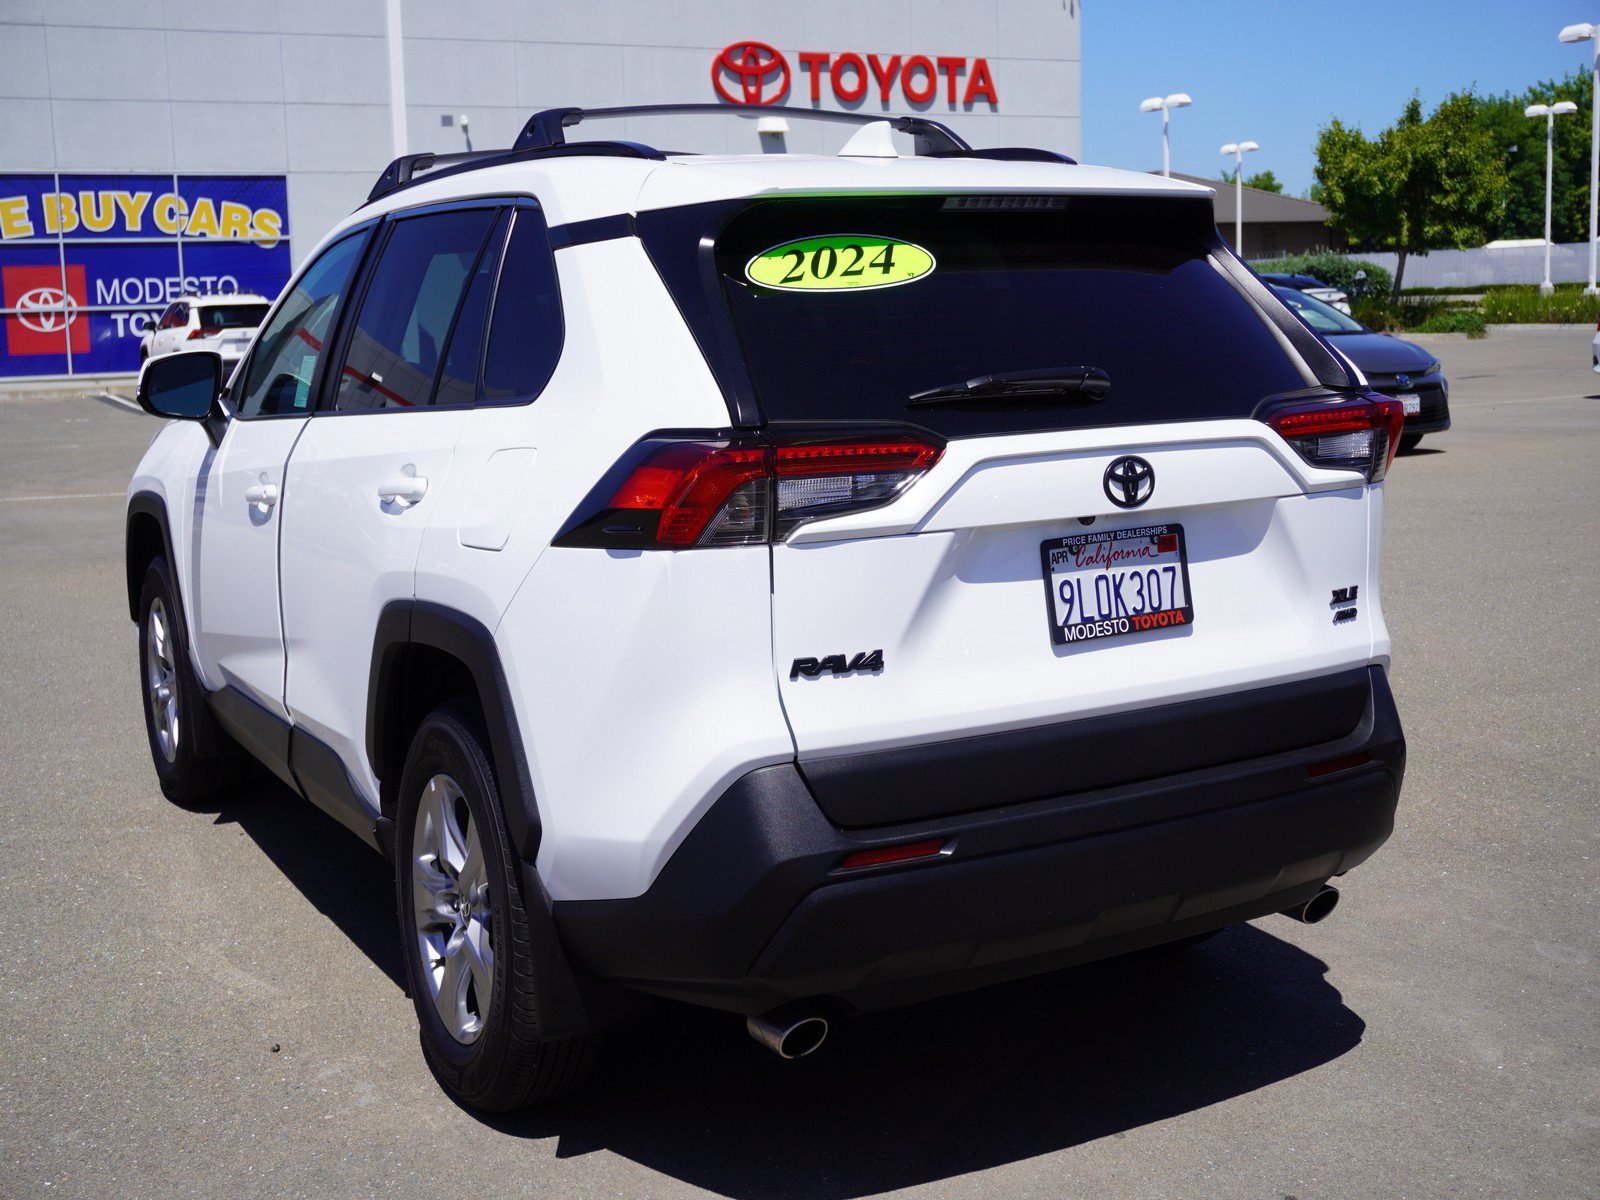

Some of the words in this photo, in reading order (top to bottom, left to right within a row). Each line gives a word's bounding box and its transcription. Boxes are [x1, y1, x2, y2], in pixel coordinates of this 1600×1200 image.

[798, 52, 998, 104] TOYOTA
[0, 195, 34, 239] E
[42, 190, 153, 234] BUY
[153, 192, 282, 248] CARS
[779, 242, 896, 284] 2024
[96, 275, 239, 304] MODESTO
[1062, 536, 1086, 547] PRICE
[1087, 532, 1115, 543] FAMILY
[1117, 525, 1168, 539] DEALERSHIPS
[1051, 550, 1068, 564] APR
[1075, 542, 1159, 571] California
[1064, 618, 1130, 641] MODESTO
[1132, 609, 1185, 630] TOYOTA
[789, 649, 884, 678] RAV4
